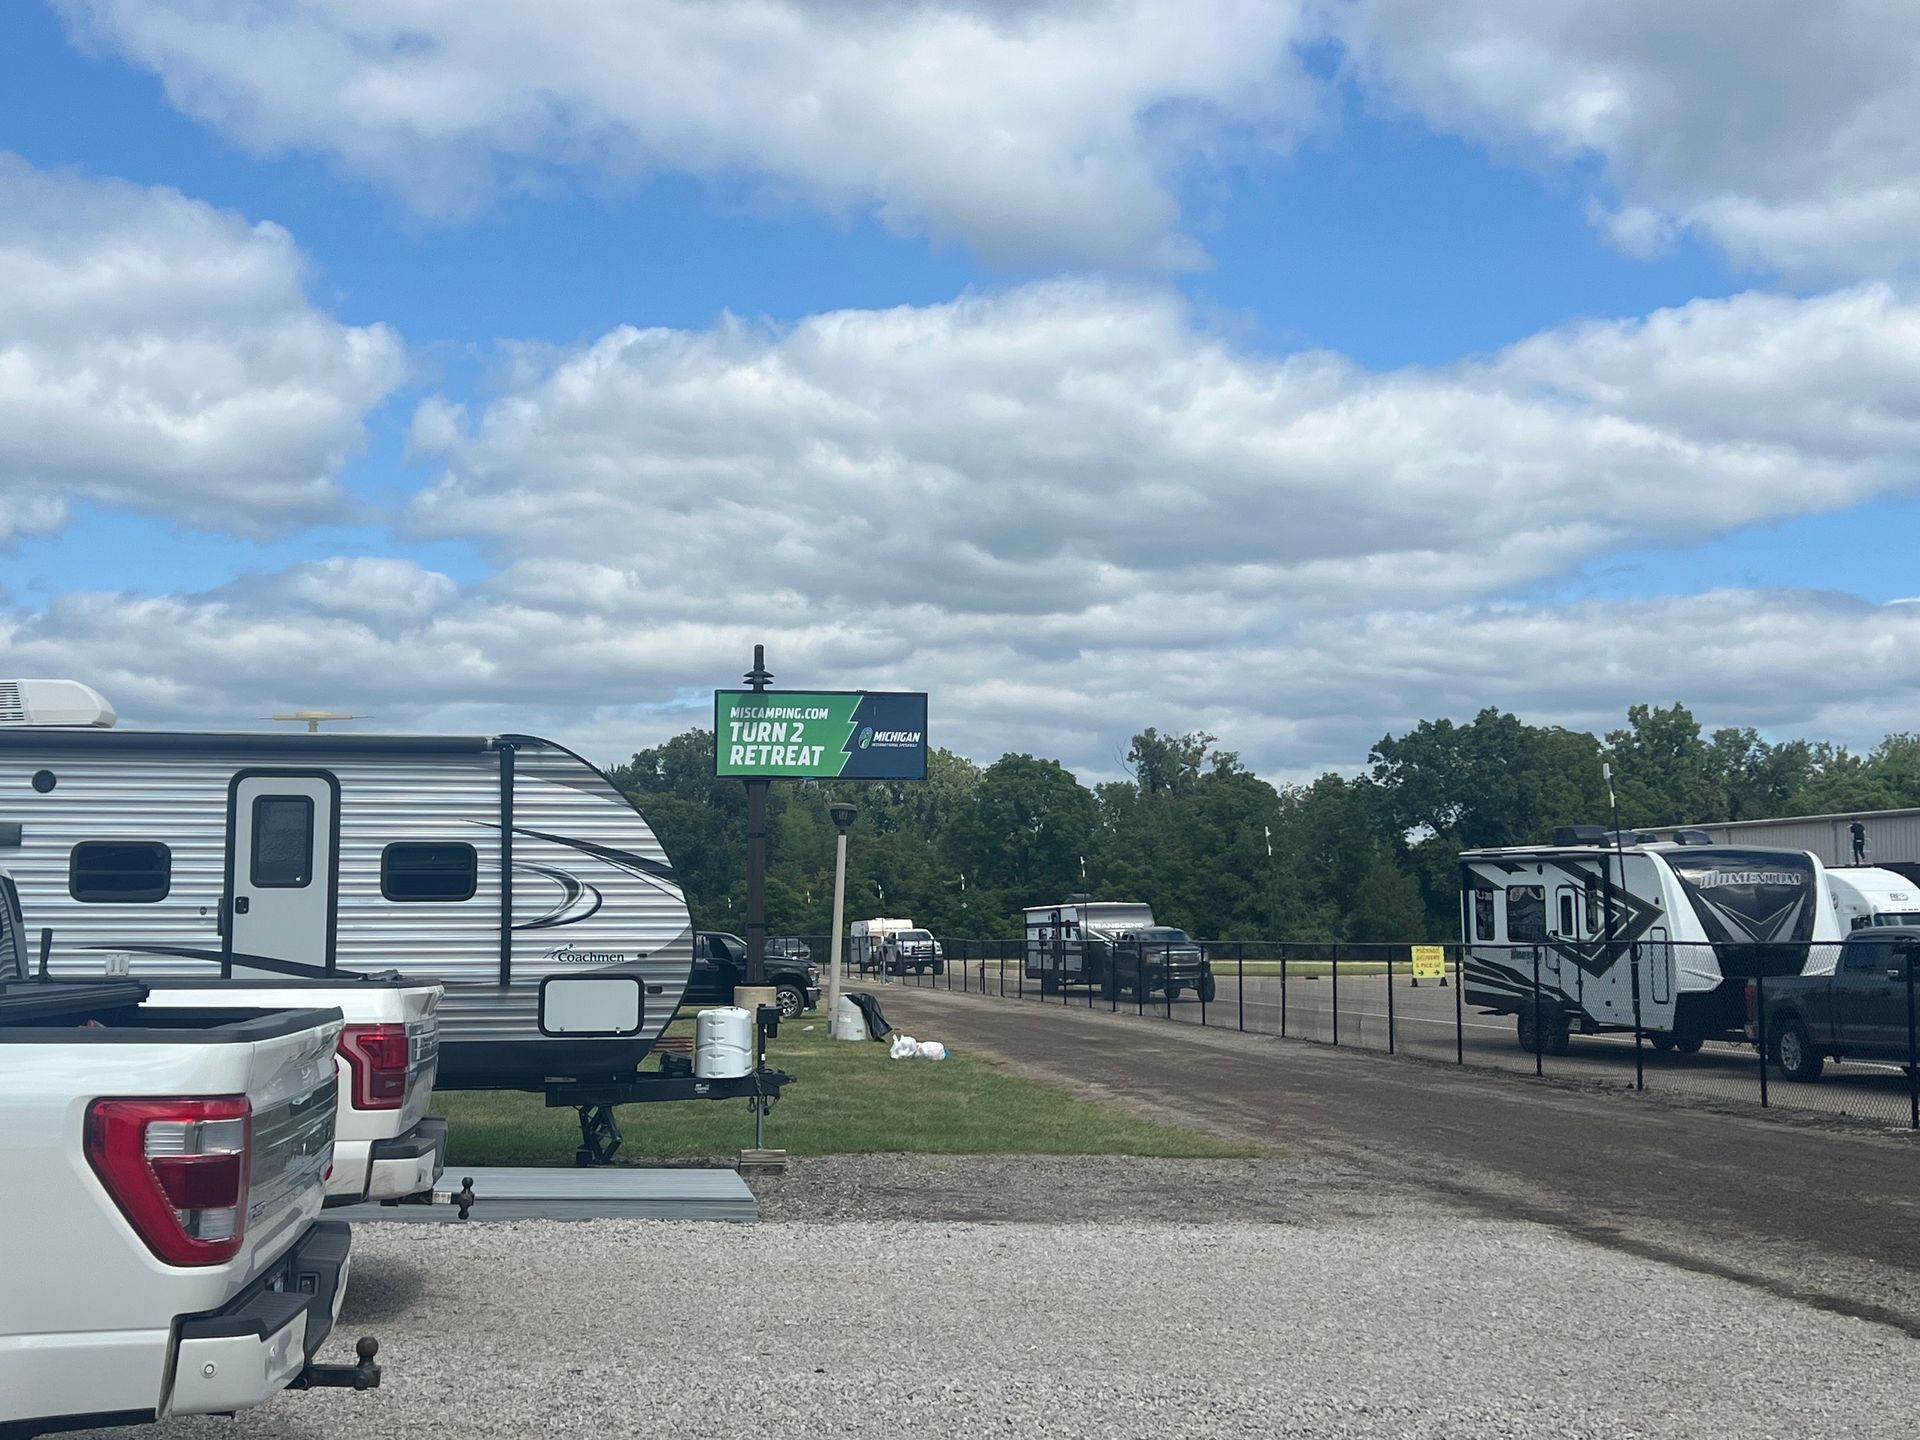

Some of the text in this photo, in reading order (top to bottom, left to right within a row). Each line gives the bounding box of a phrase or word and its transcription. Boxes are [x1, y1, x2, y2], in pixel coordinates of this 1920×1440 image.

[730, 706, 829, 720] MISCAMPING.COM
[730, 722, 804, 743] TURN 2
[873, 731, 920, 742] MICHIGAN
[730, 745, 825, 766] RETREAT
[1700, 869, 1801, 889] MOMENTUM
[558, 952, 624, 962] Coachmen
